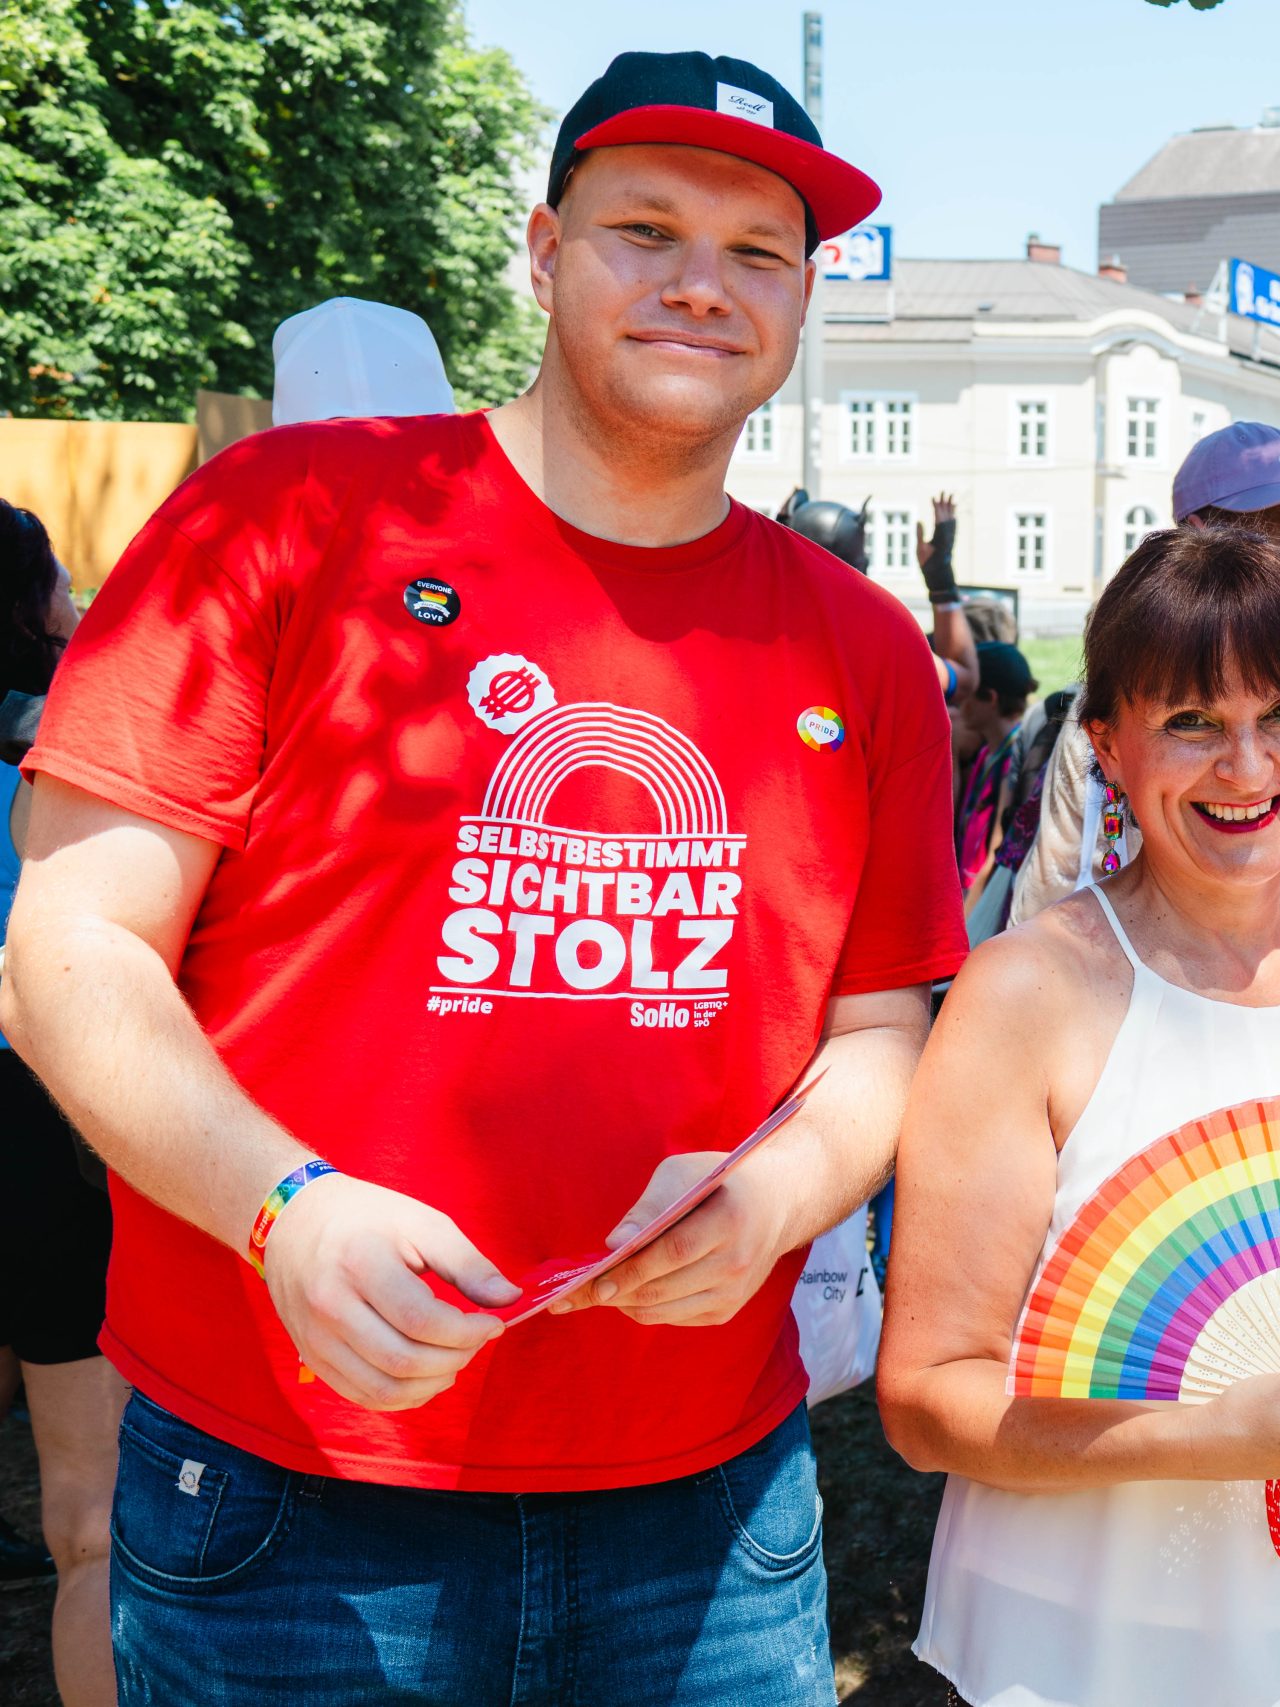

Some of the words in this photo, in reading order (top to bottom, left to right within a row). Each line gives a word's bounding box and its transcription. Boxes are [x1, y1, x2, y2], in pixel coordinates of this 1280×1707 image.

[416, 580, 453, 595] EVERYONE
[417, 610, 444, 623] LOVE
[809, 721, 835, 738] PRIDE
[456, 825, 747, 868] SELBSTBESTIMMT
[448, 857, 743, 917] SICHTBAR
[436, 907, 735, 990] STOLZ
[426, 995, 493, 1016] #pride
[693, 1001, 728, 1010] LGBTIQ+
[630, 1001, 690, 1028] SoHo
[693, 1010, 702, 1019] in
[702, 1010, 717, 1019] der
[693, 1017, 710, 1028] SPÖ
[800, 1269, 848, 1285] Rainbow
[823, 1286, 846, 1303] City
